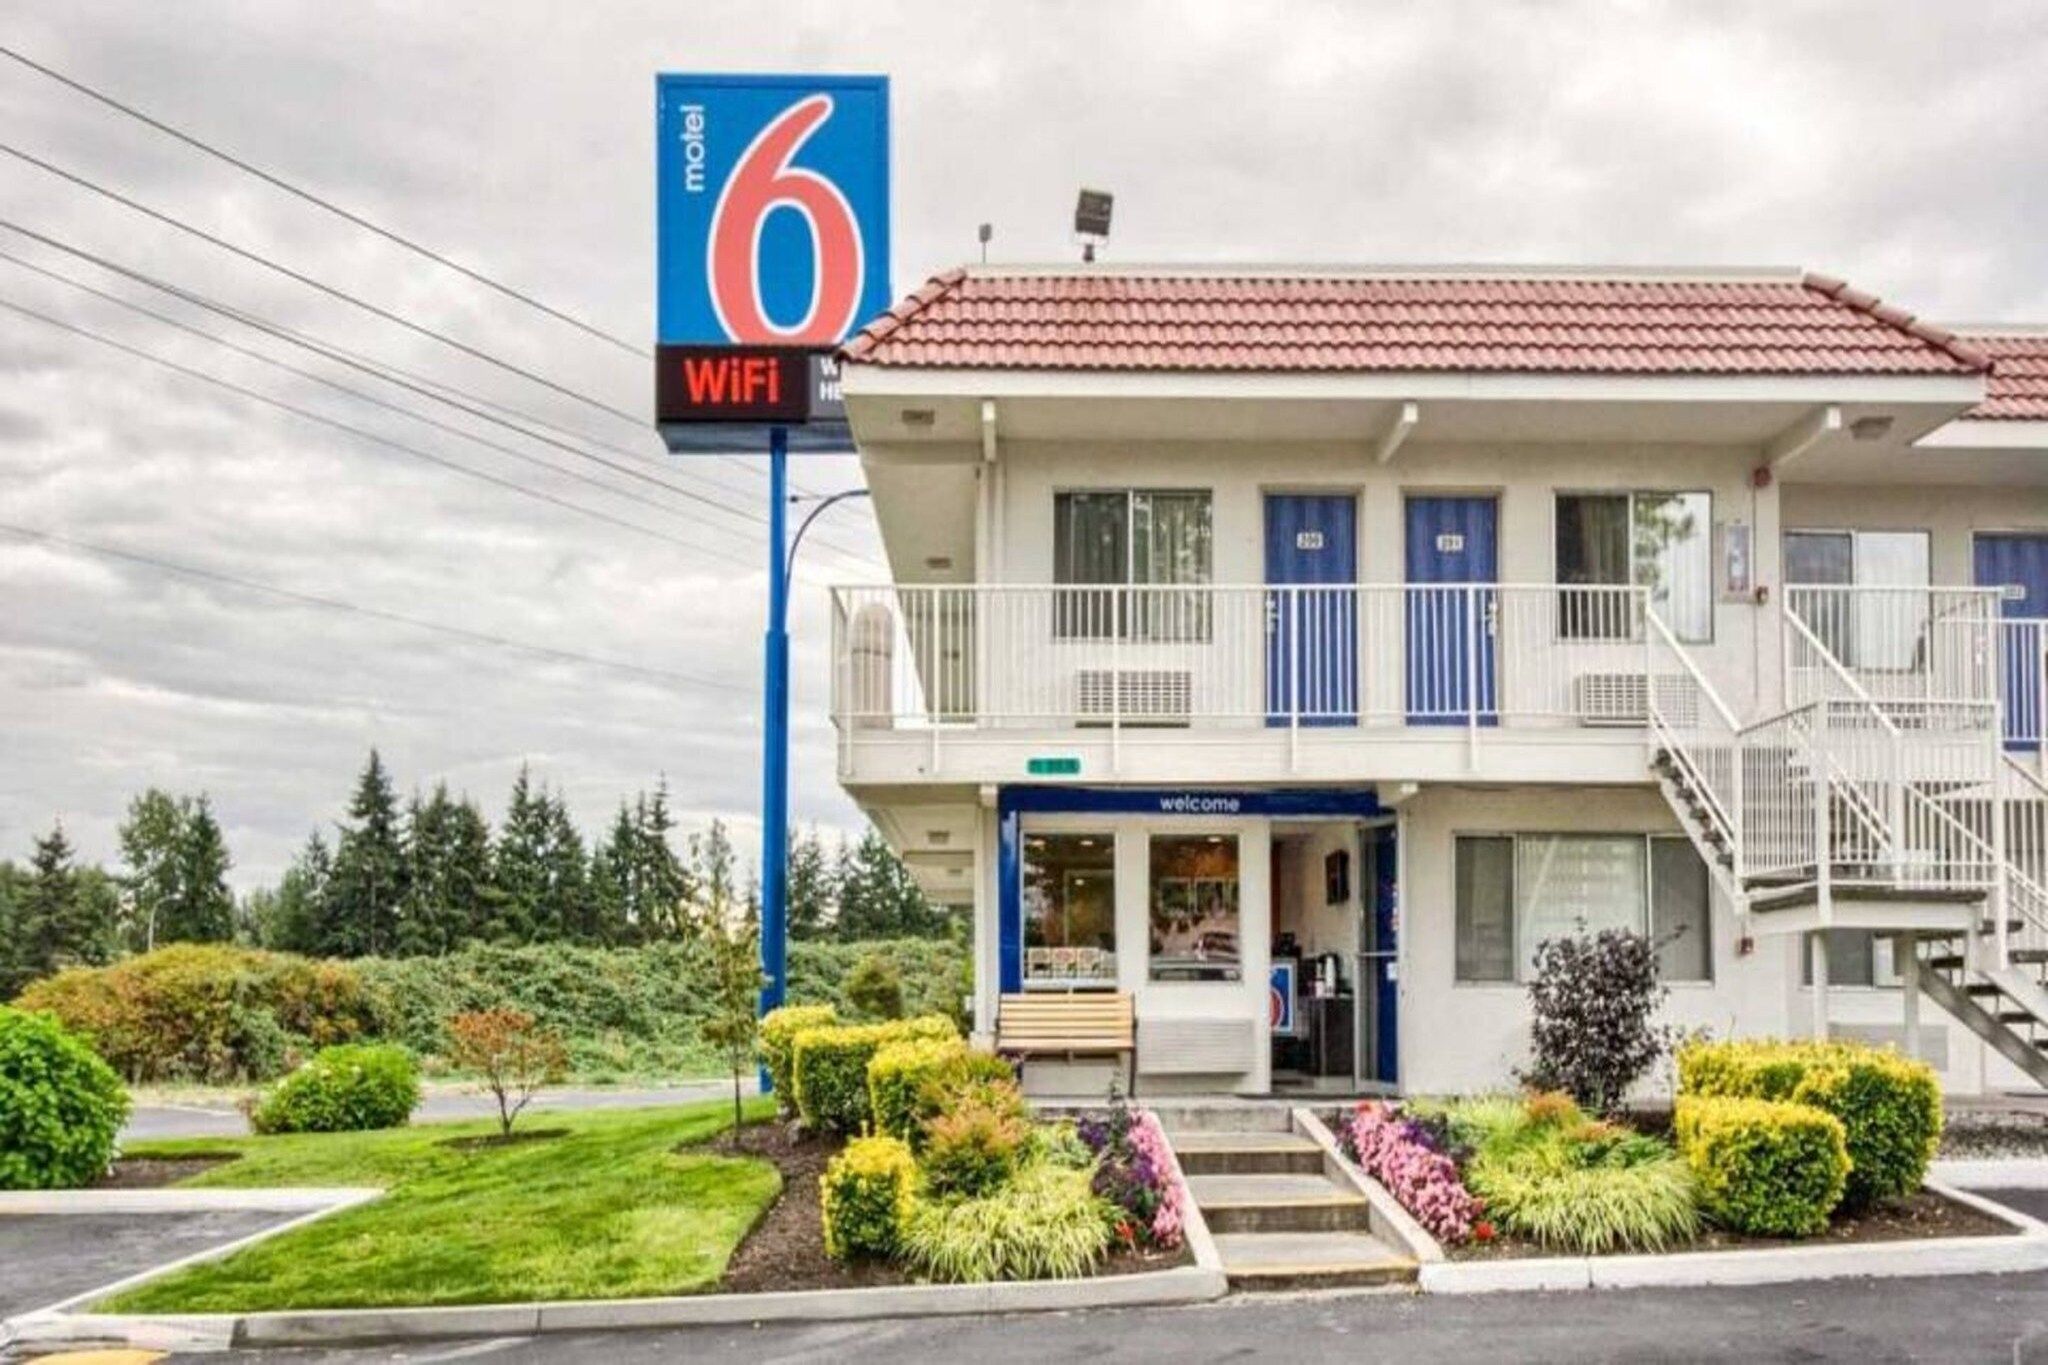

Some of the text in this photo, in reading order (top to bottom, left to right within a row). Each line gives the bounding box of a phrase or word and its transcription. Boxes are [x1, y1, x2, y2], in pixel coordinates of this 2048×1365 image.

[679, 104, 704, 192] motel
[706, 93, 865, 344] 6
[684, 357, 779, 404] WiFi
[1160, 794, 1240, 812] welcome
